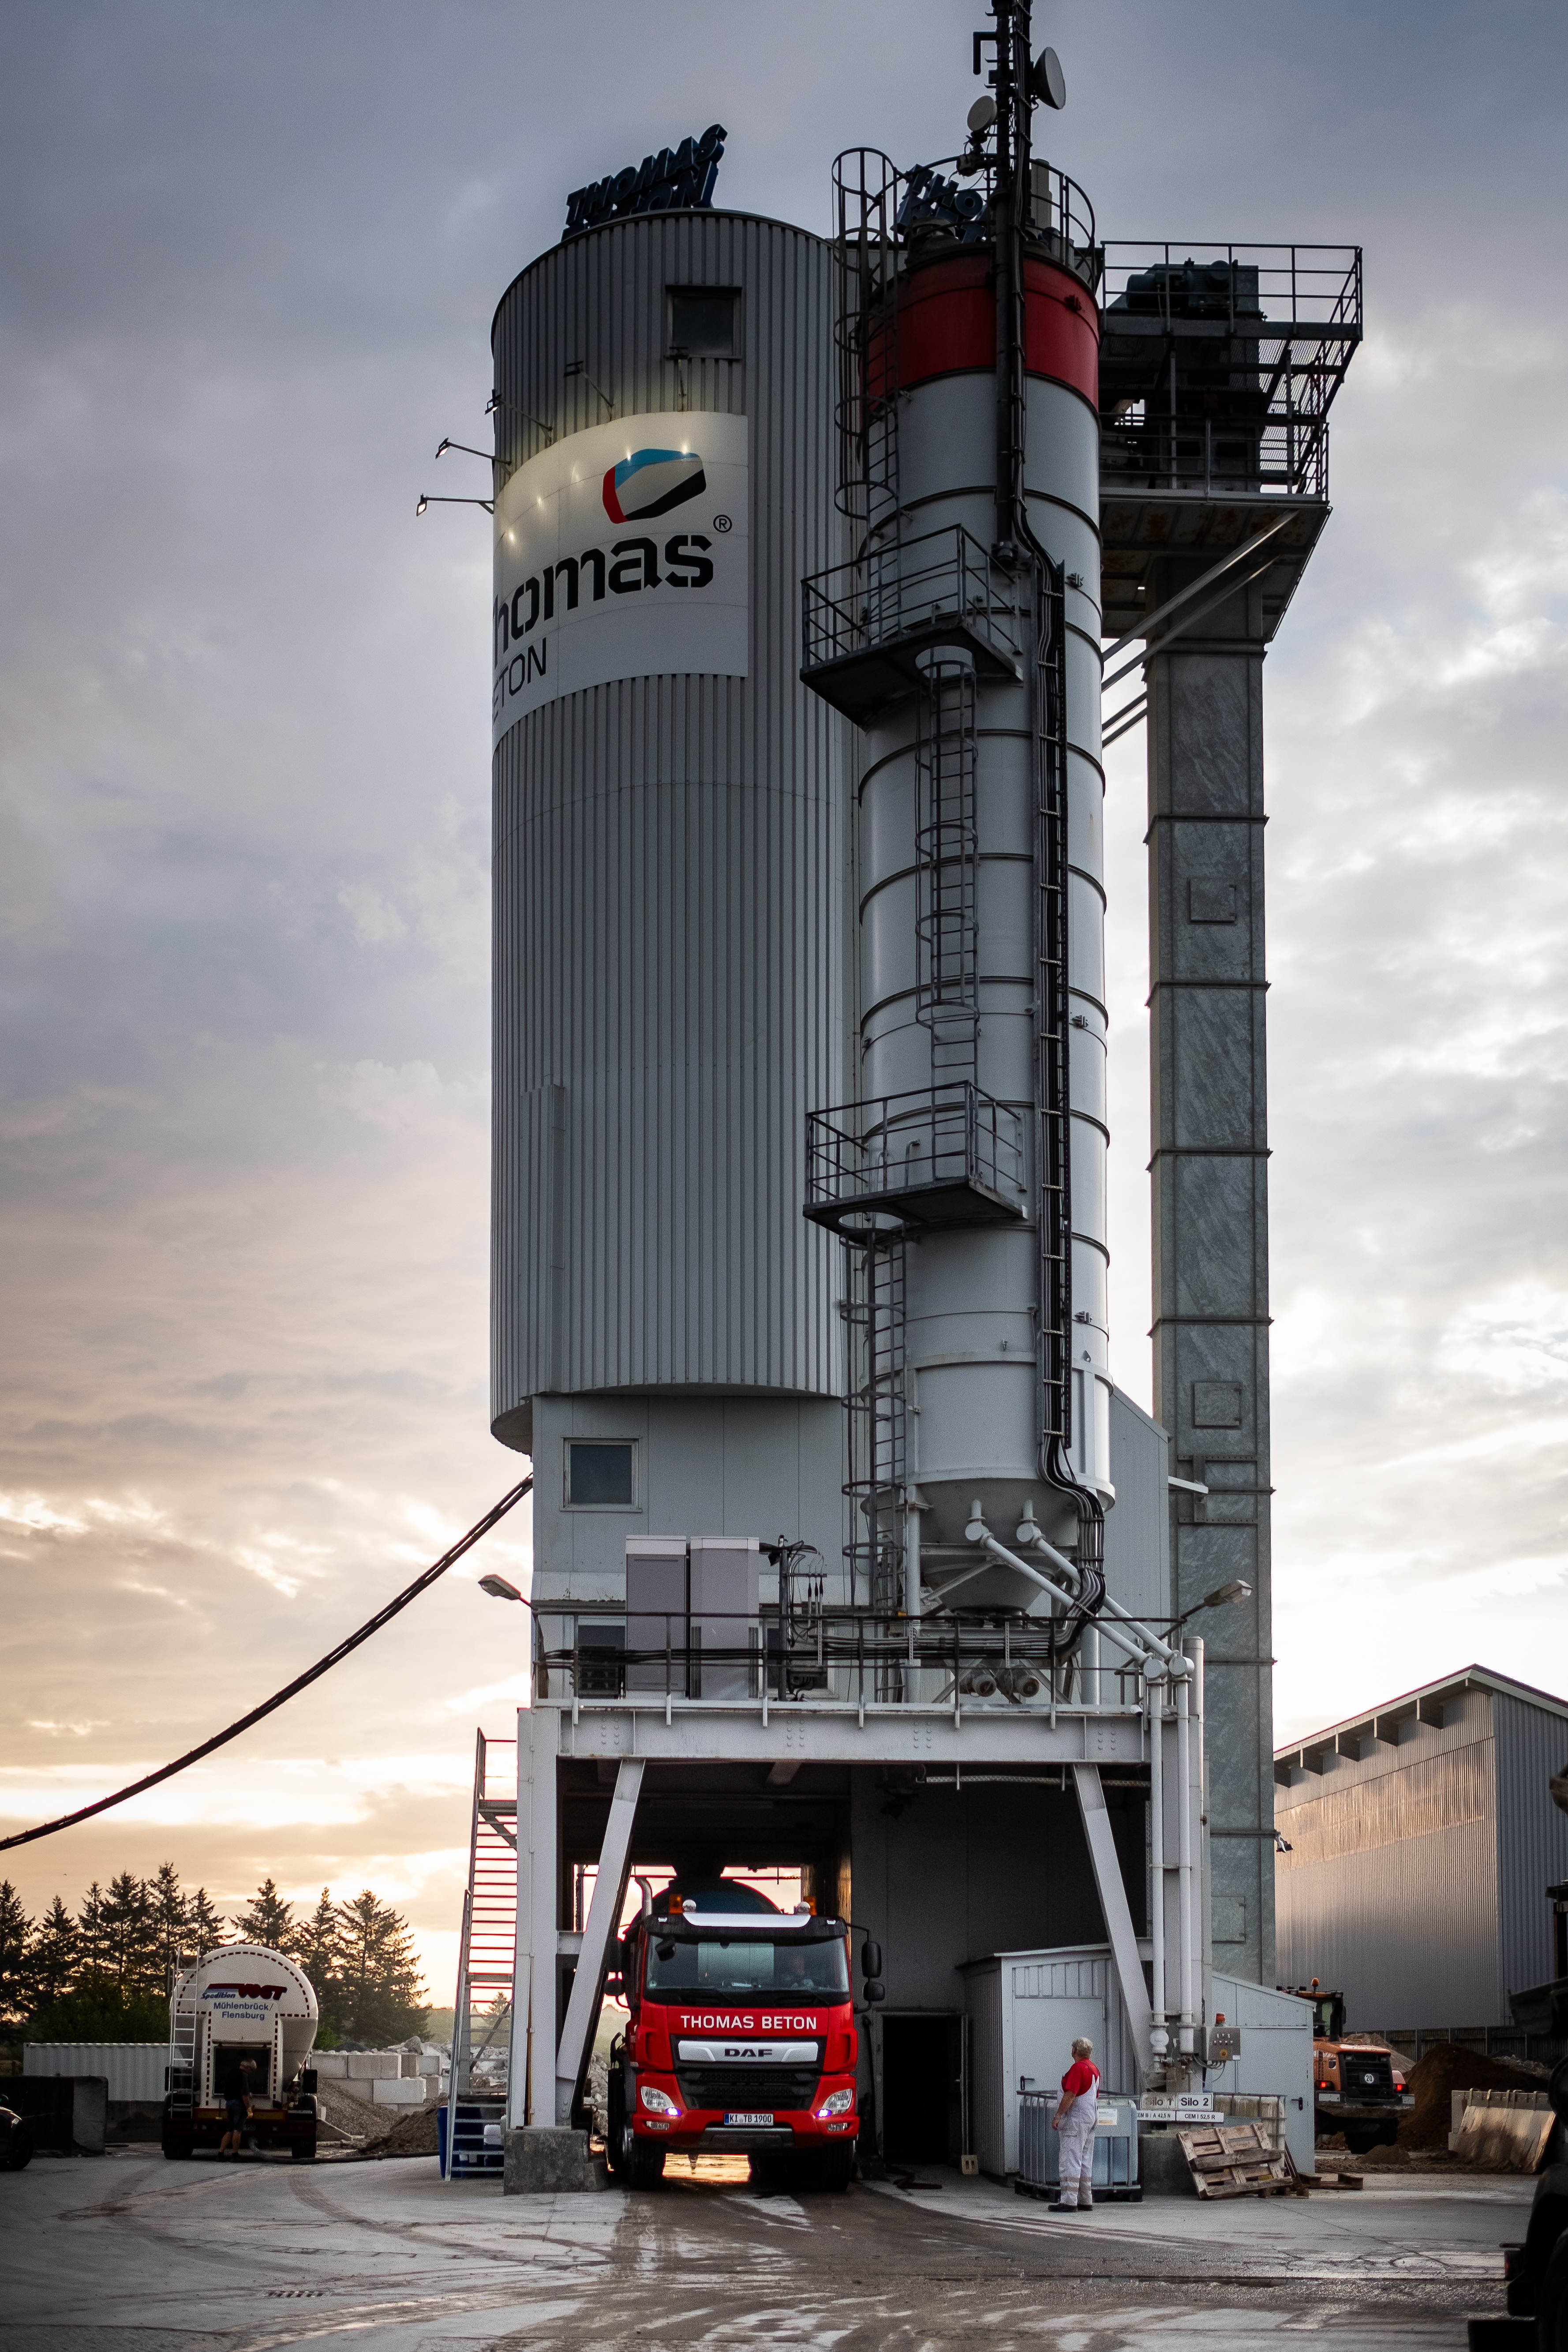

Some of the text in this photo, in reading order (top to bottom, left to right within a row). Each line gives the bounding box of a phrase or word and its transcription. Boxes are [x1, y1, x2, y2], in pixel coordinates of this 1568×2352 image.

[565, 123, 728, 226] THOMAS
[493, 535, 714, 670] homas
[213, 2002, 274, 2012] Mühlenbrück/
[222, 2011, 265, 2021] Flensburg
[680, 2015, 816, 2030] THOMAS BETON
[724, 2048, 773, 2057] DAF
[1180, 2097, 1209, 2106] Silo 2
[730, 2114, 772, 2123] KI TB 1900
